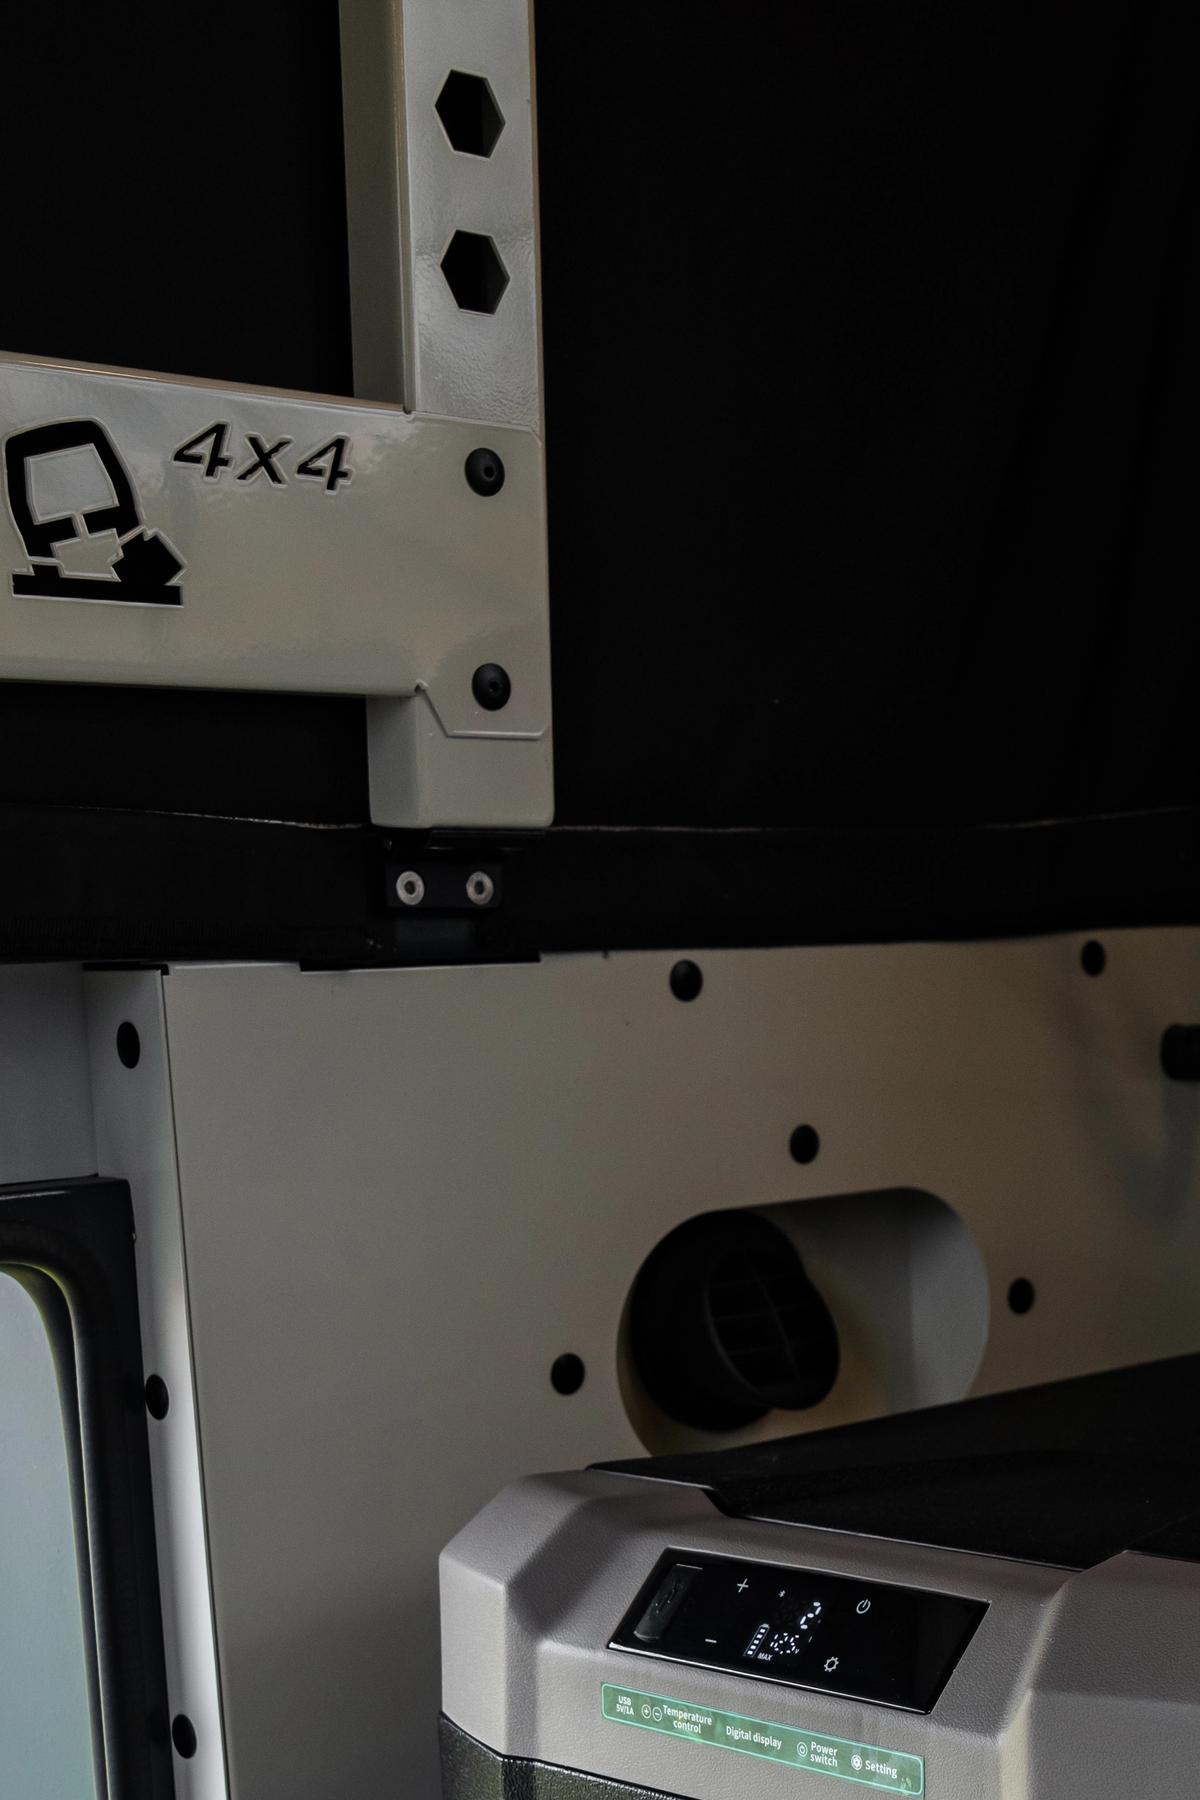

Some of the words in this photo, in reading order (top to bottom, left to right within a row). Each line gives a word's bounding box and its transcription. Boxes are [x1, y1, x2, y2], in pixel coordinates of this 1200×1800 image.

[757, 1652, 773, 1661] MAX
[618, 1695, 632, 1706] USB
[616, 1703, 635, 1716] 5V/1A
[662, 1704, 713, 1726] Temperature
[673, 1719, 702, 1735] control
[726, 1725, 752, 1741] Digital
[752, 1733, 782, 1751] display
[811, 1741, 838, 1757] Power
[810, 1752, 838, 1768] switch
[865, 1759, 898, 1779] Setting
